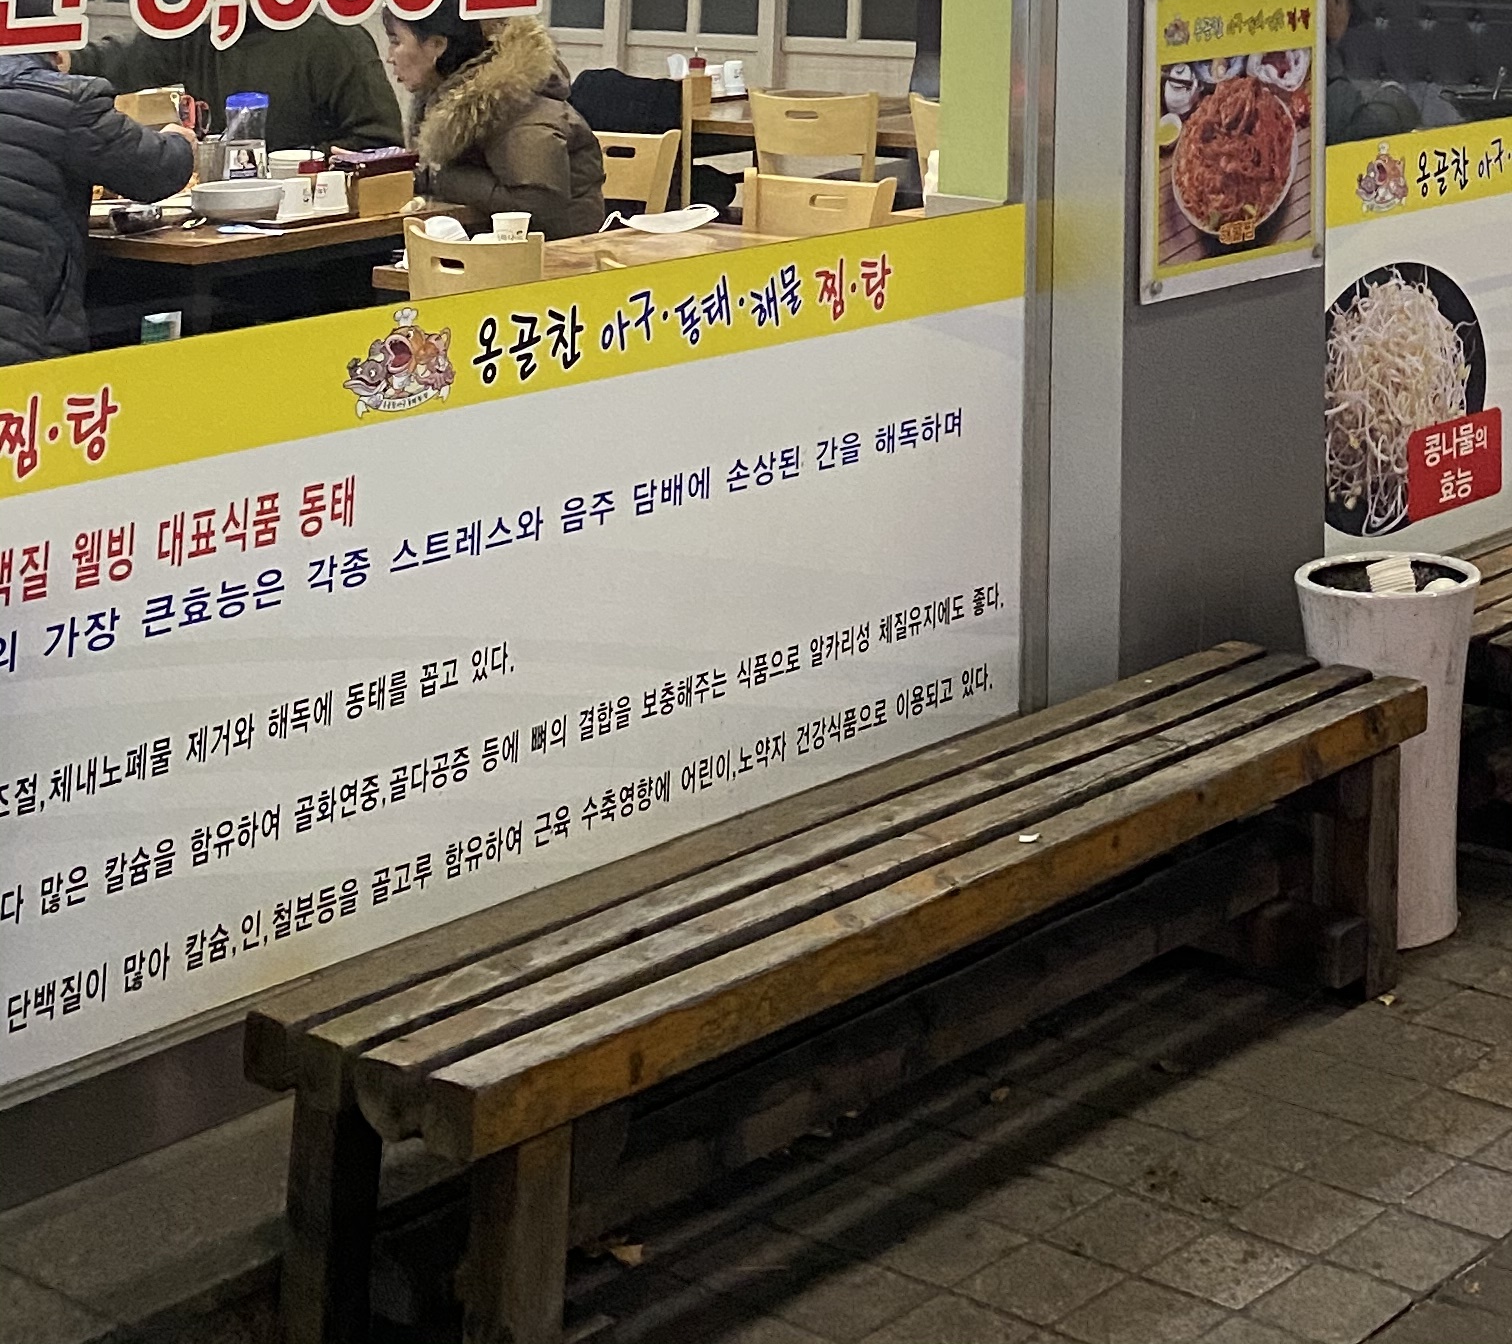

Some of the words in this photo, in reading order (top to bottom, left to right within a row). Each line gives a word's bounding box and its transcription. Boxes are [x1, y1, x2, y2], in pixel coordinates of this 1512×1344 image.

[1415, 145, 1470, 198] 옹골찬
[472, 305, 585, 385] 옹골찬
[1422, 422, 1490, 467] 콩나물의
[1438, 469, 1475, 503] 효능
[43, 606, 120, 659] 가장
[141, 568, 285, 639] 큰효능은
[307, 546, 371, 595] 각종
[390, 506, 545, 576] 스트레스와
[559, 491, 616, 536] 음주
[633, 466, 711, 518] 담배에
[726, 445, 802, 495] 손상된
[816, 431, 862, 472] 간을
[874, 407, 963, 457] 해독하며
[73, 521, 137, 592] 웰빙
[156, 490, 281, 569] 대표식품
[299, 474, 357, 539] 동태
[40, 865, 89, 916] 많은
[104, 838, 177, 895] 칼슘을
[190, 803, 281, 868] 함유하여
[481, 728, 520, 773] 등에
[530, 713, 568, 755] 뼈의
[578, 695, 633, 742] 결합을
[640, 666, 728, 722] 보충해주는
[736, 643, 802, 688] 식품으로
[809, 619, 871, 668] 알카리성
[879, 595, 965, 646] 체질유지에도
[973, 581, 1005, 615] 좋다.
[186, 713, 255, 763] 제거와
[267, 690, 333, 741] 해독에
[345, 669, 408, 721] 동태를
[419, 657, 460, 705] 꼽고
[470, 640, 515, 684] 있다.
[6, 962, 108, 1034] 단백질이
[123, 941, 171, 994] 많아
[371, 852, 433, 907] 골고루
[444, 819, 523, 880] 함유하여
[533, 805, 571, 848] 근육
[580, 768, 673, 831] 수축영향에
[795, 698, 888, 757] 건강식품으로
[895, 673, 954, 722] 이용되고
[961, 662, 994, 700] 있다.
